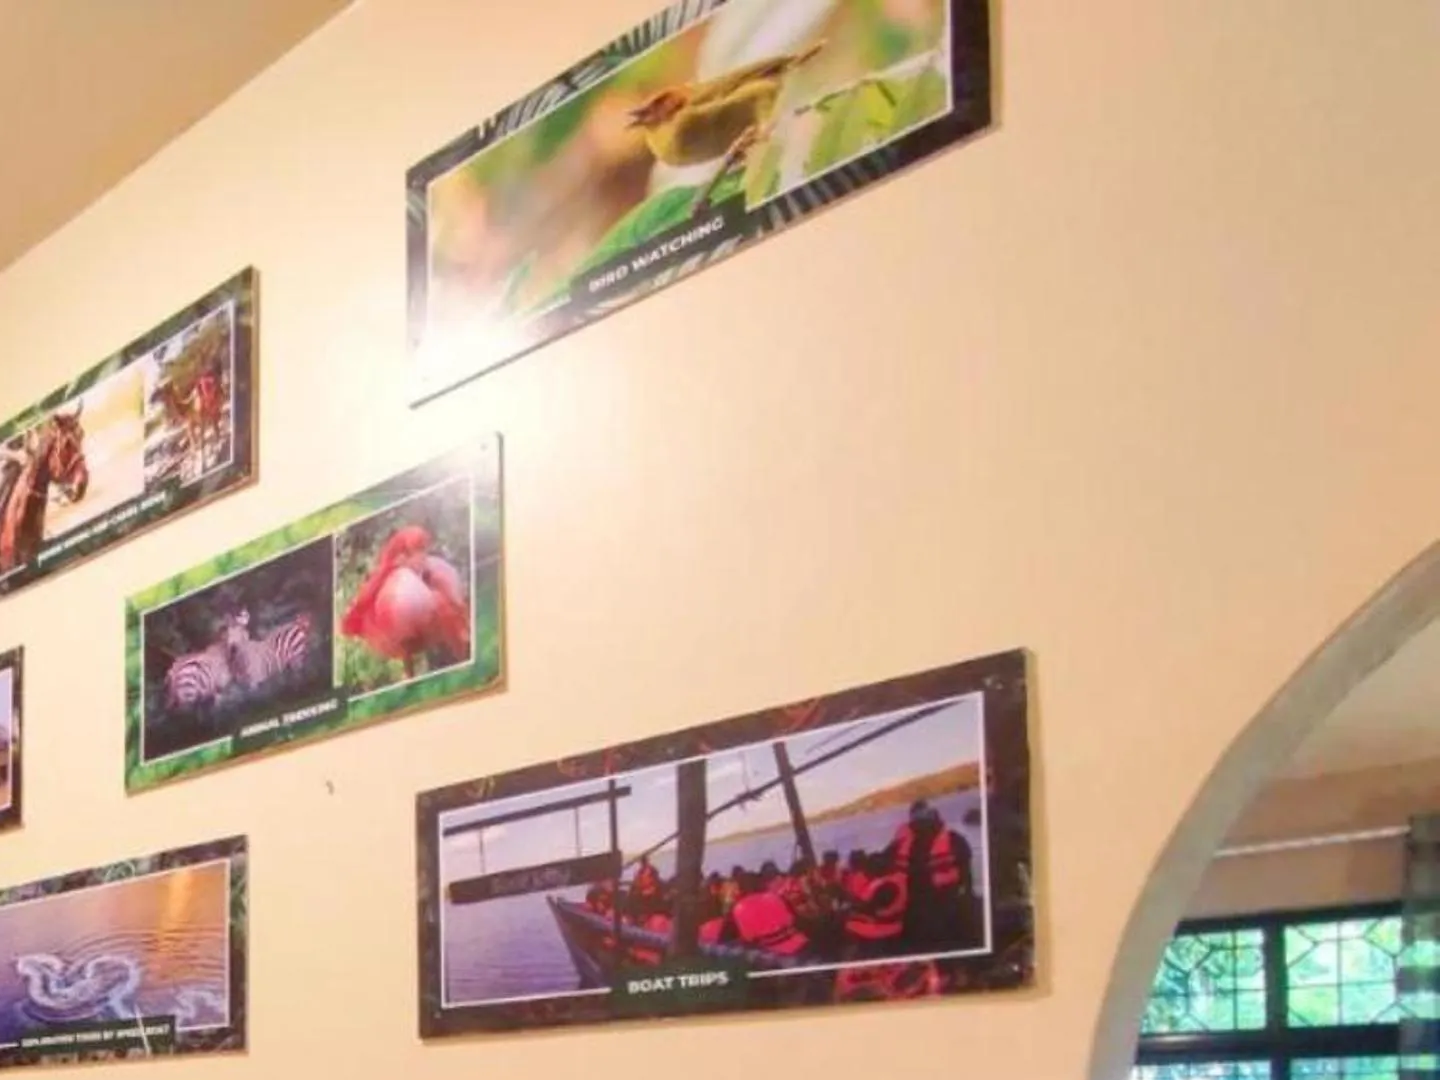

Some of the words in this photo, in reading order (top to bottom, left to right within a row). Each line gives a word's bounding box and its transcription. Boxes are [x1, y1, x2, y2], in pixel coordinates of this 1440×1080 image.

[588, 264, 629, 293] BIRD
[632, 215, 725, 271] WATCHING
[627, 976, 674, 995] BOAT
[675, 971, 729, 988] TRIPS
